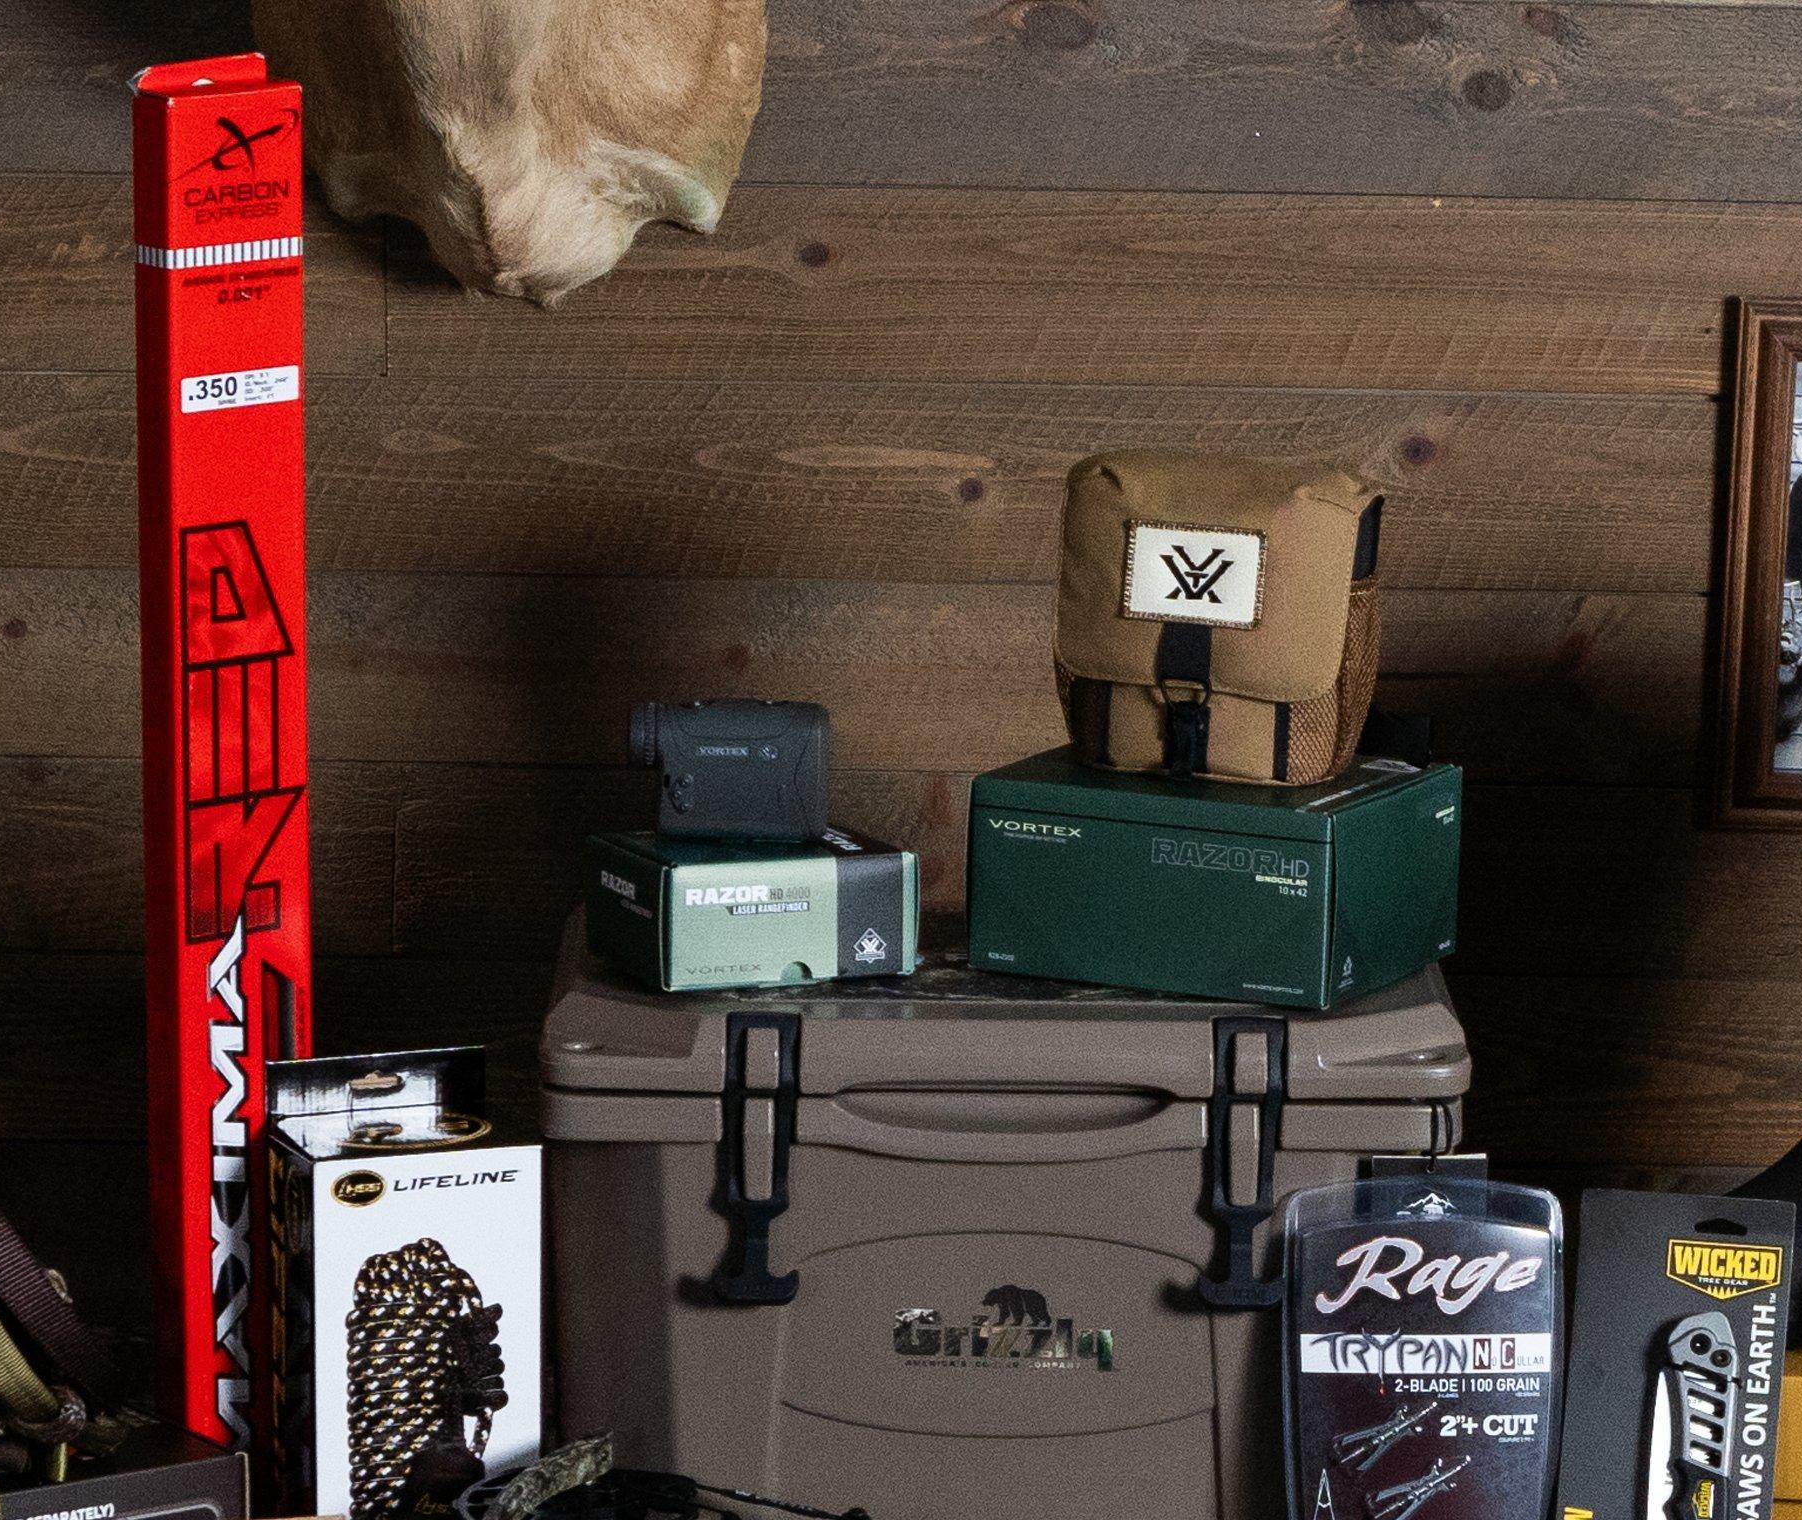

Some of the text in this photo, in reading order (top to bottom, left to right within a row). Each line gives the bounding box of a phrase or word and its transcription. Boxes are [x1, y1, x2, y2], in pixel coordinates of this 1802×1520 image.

[184, 179, 290, 208] CARBON
[194, 201, 282, 225] EXPRESS
[189, 376, 239, 402] .350
[698, 745, 750, 759] VORTEX
[988, 818, 1082, 839] VORTEX
[1150, 837, 1311, 879] RAZOR HD
[600, 869, 637, 901] RAZOR
[1255, 874, 1309, 887] BINOCULAR
[1278, 885, 1289, 896] 10
[1296, 887, 1309, 898] 42
[685, 884, 770, 906] RAZOR
[732, 901, 810, 916] LASER RANGEFINDER
[685, 963, 762, 976] VORTEX
[394, 1169, 521, 1192] LIFELINE
[1673, 1244, 1778, 1282] WICKED
[1315, 1235, 1543, 1316] Rage
[1697, 1276, 1749, 1287] TREE GEAR
[893, 1308, 1114, 1371] Grizzly
[1746, 1304, 1777, 1396] EARTH
[1310, 1328, 1469, 1378] TRYPAN
[1395, 1376, 1541, 1393] 2-BLADE 100 GRAIN
[1482, 1413, 1539, 1437] CUT
[1744, 1403, 1769, 1445] ON
